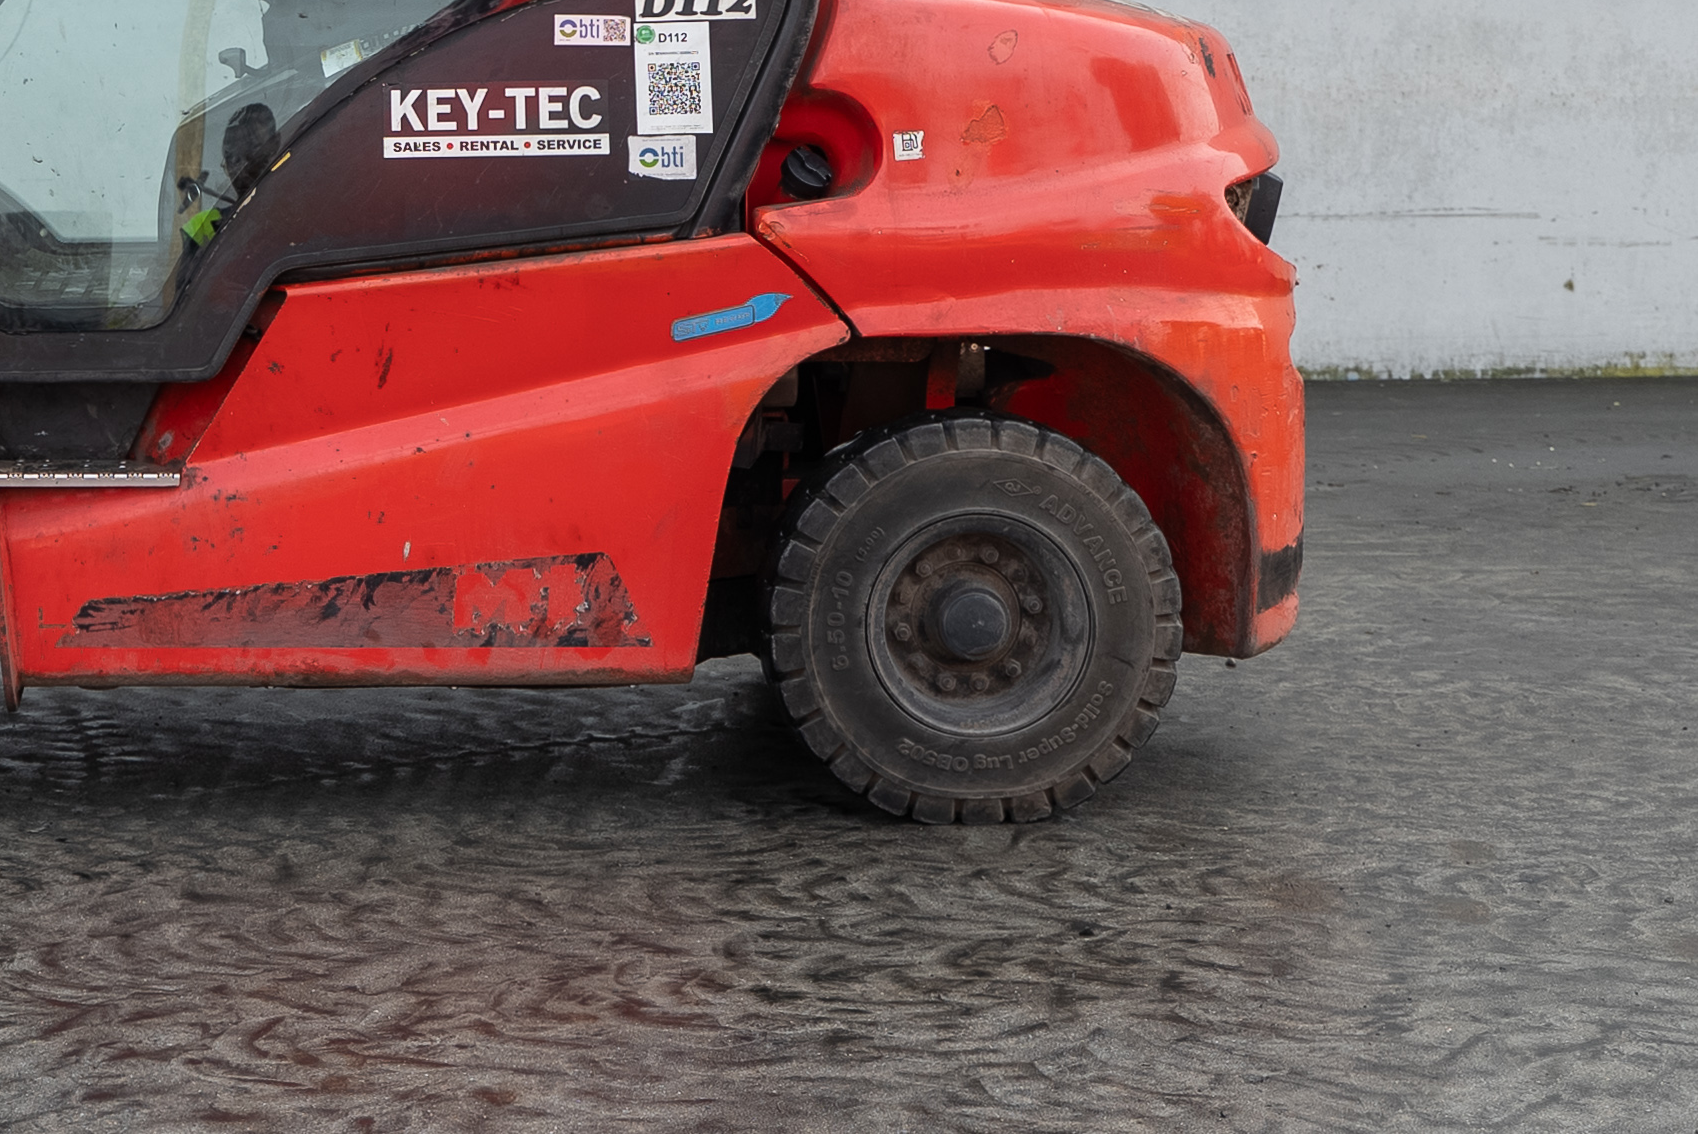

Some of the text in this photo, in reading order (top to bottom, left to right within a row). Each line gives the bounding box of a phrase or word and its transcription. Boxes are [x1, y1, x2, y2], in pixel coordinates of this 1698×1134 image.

[580, 19, 600, 38] bti
[658, 32, 688, 43] D112
[390, 86, 603, 131] KEY-TEC
[393, 138, 602, 153] SALES RENTAL SERVICE
[661, 146, 684, 168] bti
[1039, 494, 1129, 605] ADVANCE
[973, 753, 1015, 770] Lug
